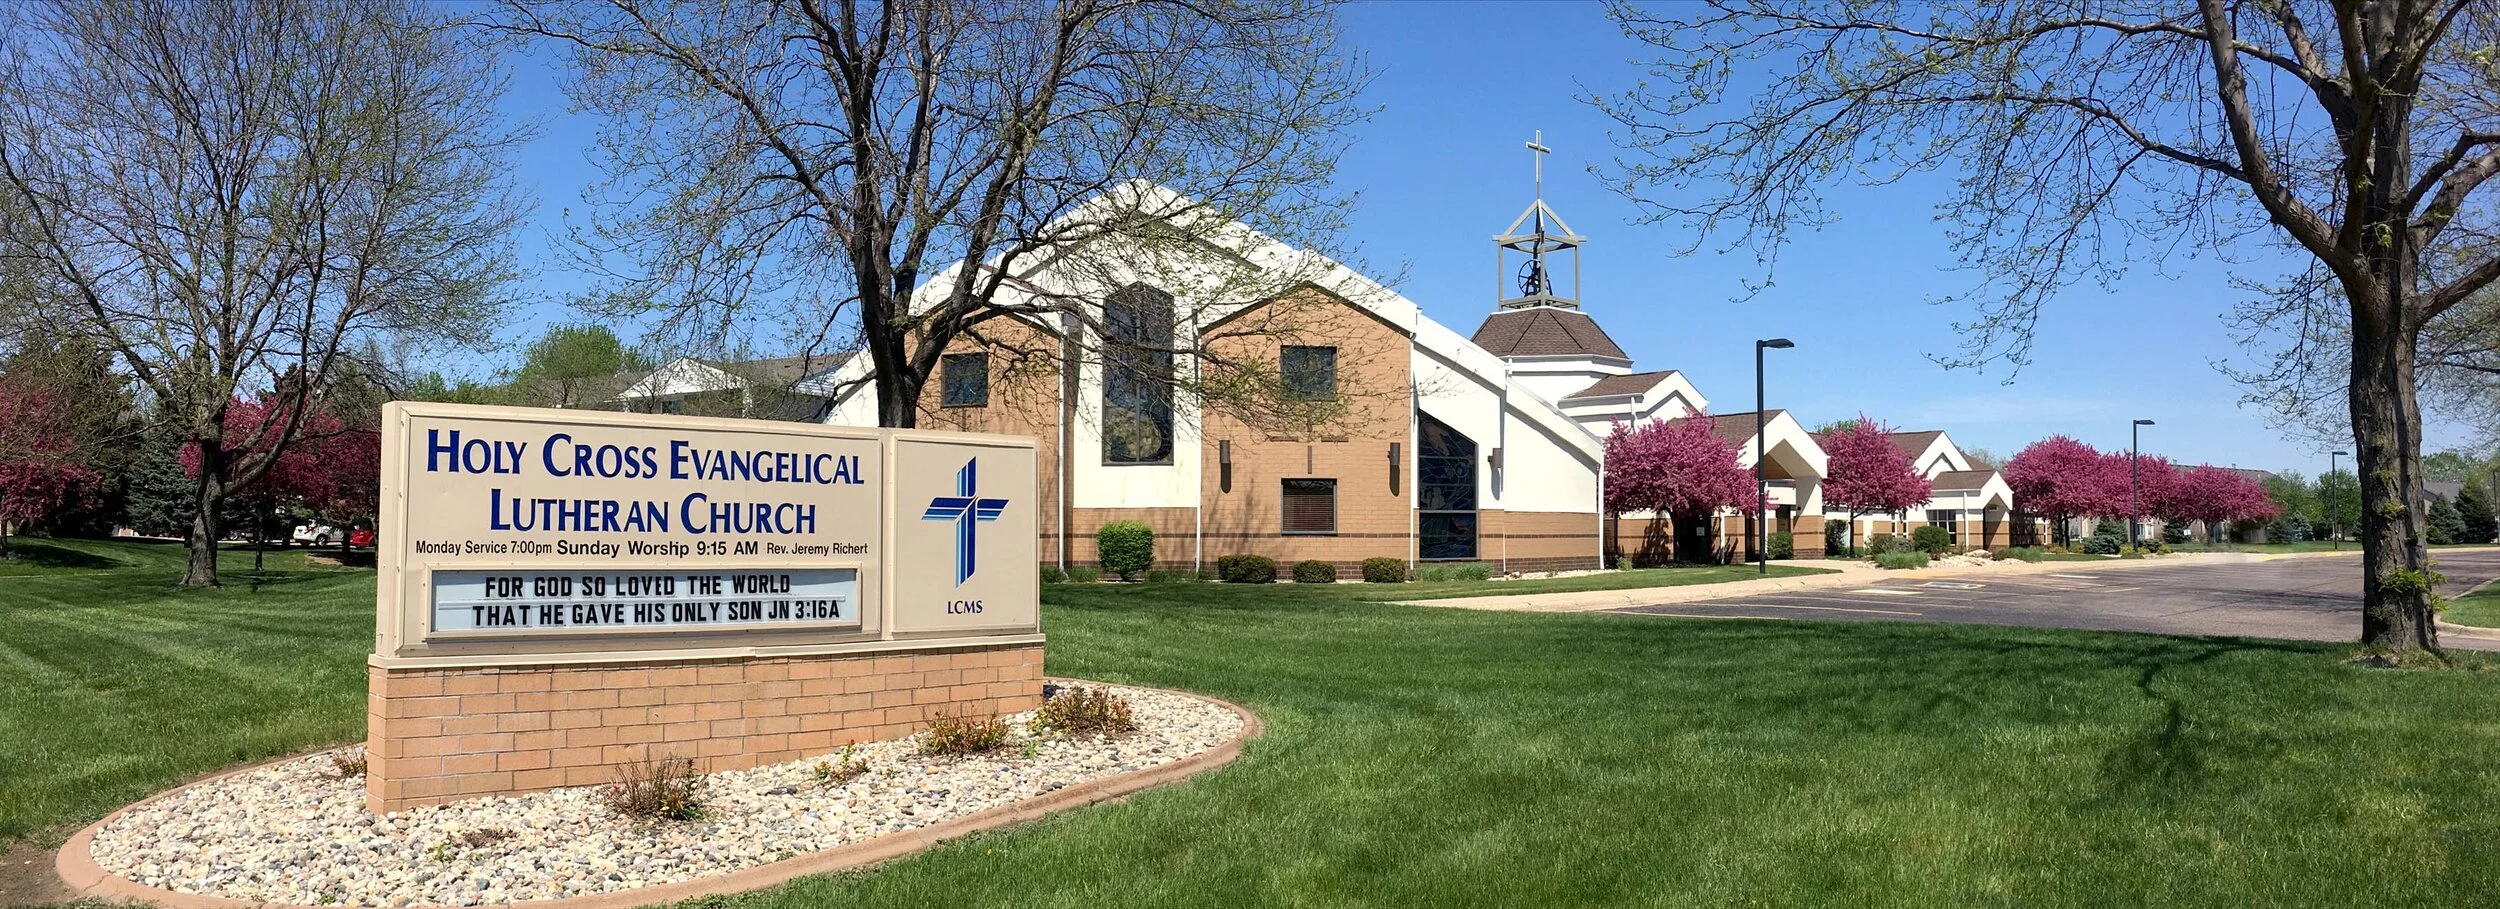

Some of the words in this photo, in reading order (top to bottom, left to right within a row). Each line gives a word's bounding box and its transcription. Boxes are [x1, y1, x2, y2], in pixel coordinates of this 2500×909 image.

[427, 429, 528, 474] HOLY
[542, 433, 658, 479] CROSS
[670, 440, 865, 484] EVANGELICAL
[490, 488, 669, 533] LUTHERAN
[680, 492, 816, 534] CHURCH
[416, 540, 461, 556] Monday
[465, 540, 508, 554] Service
[511, 541, 552, 556] 7:00pm
[556, 540, 620, 558] Sunday
[697, 541, 727, 555] 9:15
[734, 541, 759, 555] AM
[766, 543, 789, 554] Rev.
[791, 543, 829, 557] Jeremy
[832, 543, 868, 554] Richert
[485, 576, 523, 597] FOR
[534, 576, 572, 596] GOD
[582, 576, 606, 596] SO
[615, 575, 675, 596] LOVED
[687, 575, 721, 595] THE
[732, 574, 790, 593] WORLD
[472, 605, 531, 626] THAT
[540, 604, 564, 625] HE
[572, 604, 625, 624] GAVE
[634, 603, 665, 623] HIS
[672, 602, 720, 622] ONLY
[728, 601, 762, 620] SON
[768, 600, 789, 619] JN
[947, 600, 983, 614] LCMS
